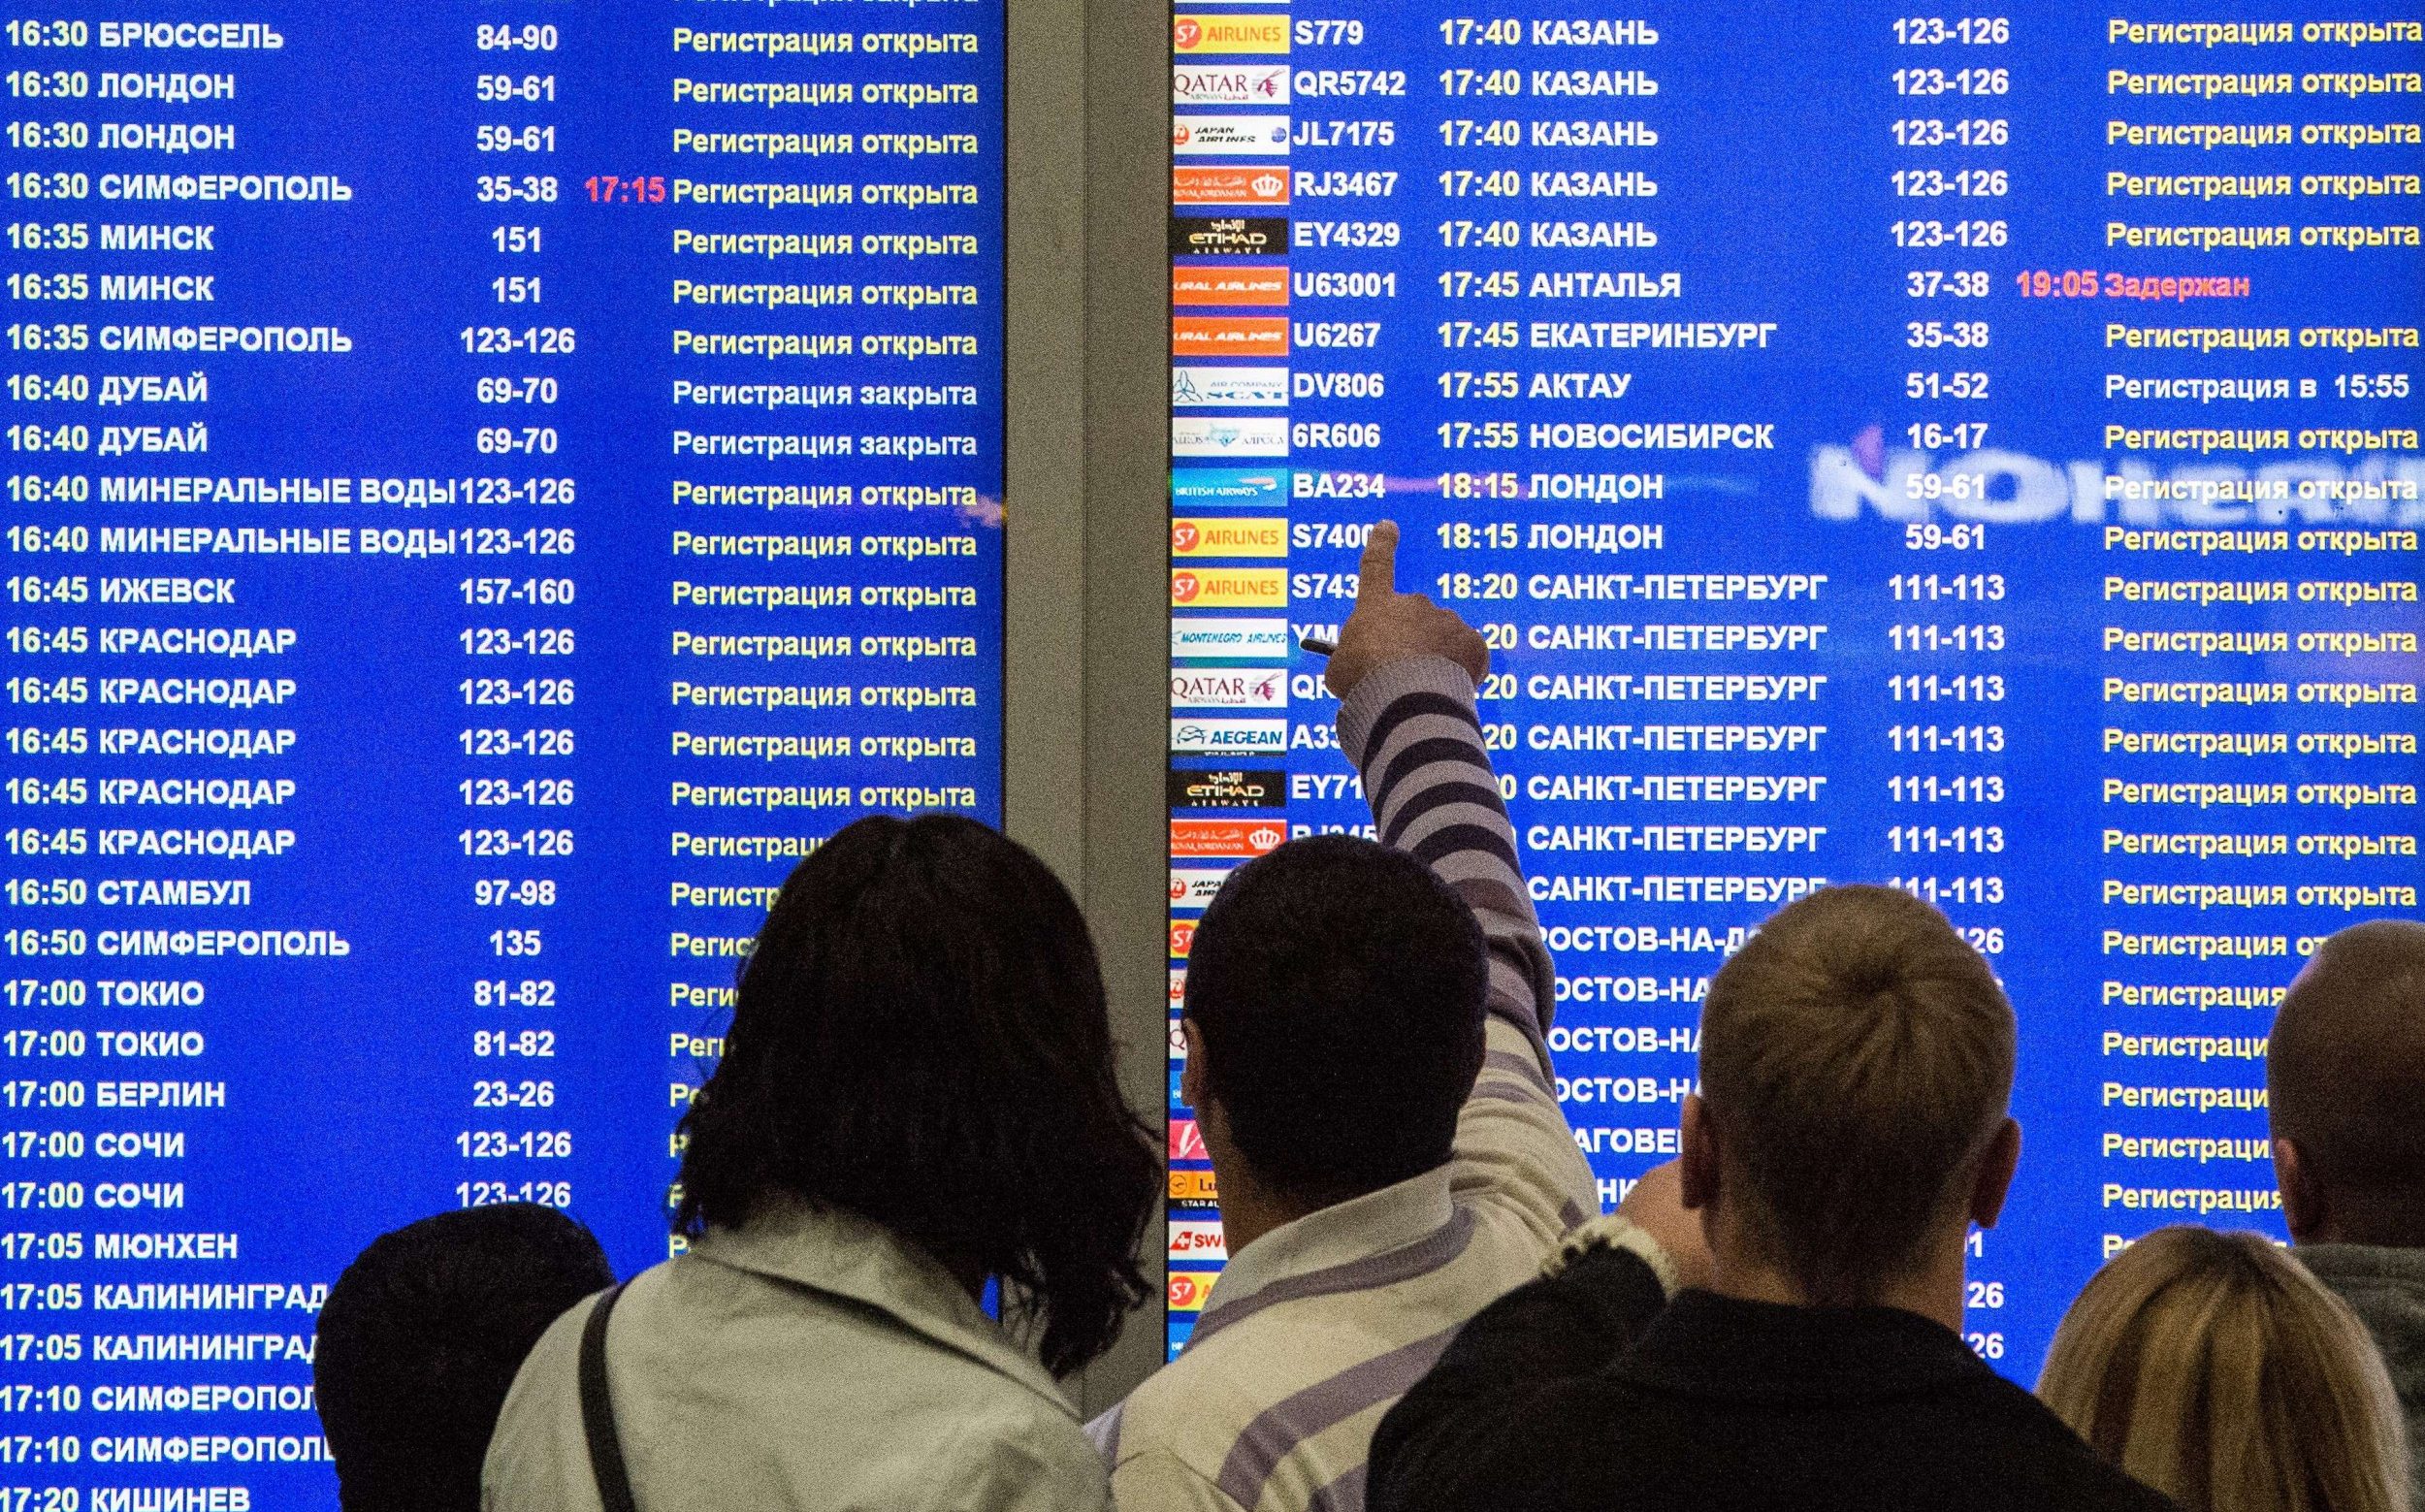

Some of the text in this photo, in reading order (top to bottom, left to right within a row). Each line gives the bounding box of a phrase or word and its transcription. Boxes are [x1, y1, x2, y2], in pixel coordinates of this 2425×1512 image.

[6, 19, 979, 59] 16:30 БРЮССЕЛЬ 84-90 Регистрация открыта
[1207, 26, 1281, 42] AIRLINES
[1294, 16, 2423, 48] S779 17:40 КАЗАНЬ 123-126 Регистрация открыта
[6, 71, 979, 110] 16:30 ЛОНДОН 59-61 Регистрация открыта
[1174, 74, 1247, 95] QATAR
[1293, 68, 2422, 100] QR5742 17:40 КАЗАНЬ 123-126 Регистрация открыта
[6, 172, 978, 209] 16:30 СИМФЕРОПОЛЬ 35-38 17:15 Регистрация открыта
[7, 222, 978, 260] 16:35 МИНСК 151 Регистрация открыта
[1189, 233, 1267, 244] ETIHAD
[1214, 281, 1282, 291] AIRLINES
[1293, 269, 2250, 304] U63001 17:45 АНТАЛЬЯ 37-38 19:05 Задержан
[1213, 332, 1282, 341] AIRLINES
[1293, 321, 2419, 354] U6267 17:45 ЕКАТЕРИНБУРГ 35-38 Регистрация открыта
[7, 370, 978, 410] 16:40 ДУБАЙ 69-70 Регистрация закрыта
[1293, 371, 2409, 404] DV806 17:55 АКТАУ 51-52 Регистрация в 15:55
[1292, 422, 1381, 448] 6R606
[1438, 421, 1519, 448] 17:55
[1530, 423, 1775, 449] НОВОСИБИРСК
[1906, 422, 1988, 449] 16-17
[2105, 425, 2289, 455] Регистрация
[2298, 429, 2419, 455] открыта
[7, 475, 978, 511] 16:40 МИНЕРАЛЬНЫЕ ВОДЫ 123-126 Регистрация открыта
[1215, 486, 1259, 497] AIRWAYS
[1293, 472, 2418, 506] BA234 18:15 ЛОНДОН 59-61 Регистрация открыта
[1205, 531, 1278, 544] AIRLINES
[6, 576, 977, 612] 16:45 ИЖЕВСК 157-160 Регистрация открыта
[1205, 581, 1278, 595] AIRLINES
[1437, 572, 1518, 599] 18:20
[1528, 574, 1828, 600] САНКТ-ПЕТЕРБУРГ
[1889, 573, 2005, 601] 111-113
[2104, 576, 2288, 607] Регистрация
[2296, 581, 2418, 607] открыта
[6, 627, 977, 662] 16:45 КРАСНОДАР 123-126 Регистрация открыта
[1181, 632, 1242, 643] MONTENEGRO
[1172, 677, 1245, 698] QATAR
[1211, 731, 1282, 745] AEGEAN
[1527, 724, 2417, 759] САНКТ-ПЕТЕРБУРГ 111-113 Регистрация открыта
[1186, 785, 1265, 796] ETIHAD
[5, 879, 556, 906] 16:50 СТАМБУЛ 97-98
[2103, 880, 2287, 911] Регистрация
[2296, 885, 2417, 912] открыта
[4, 929, 541, 956] 16:50 СИМФЕРОПОЛЬ 135
[2103, 930, 2287, 961] Регистрация
[4, 980, 556, 1007] 17:00 ТОКИО 81-82
[2102, 981, 2285, 1012] Регистрация
[3, 1080, 555, 1108] 17:00 БЕРЛИН 23-26
[2, 1131, 571, 1158] 17:00 СОЧИ 123-126
[1, 1232, 238, 1259] 17:05 МЮНХЕН
[0, 1283, 82, 1309] 17:05
[0, 1385, 314, 1412] 17:10 СИМФЕРОПОЛ
[0, 1487, 250, 1512] 17:20 КИШИНЕВ
